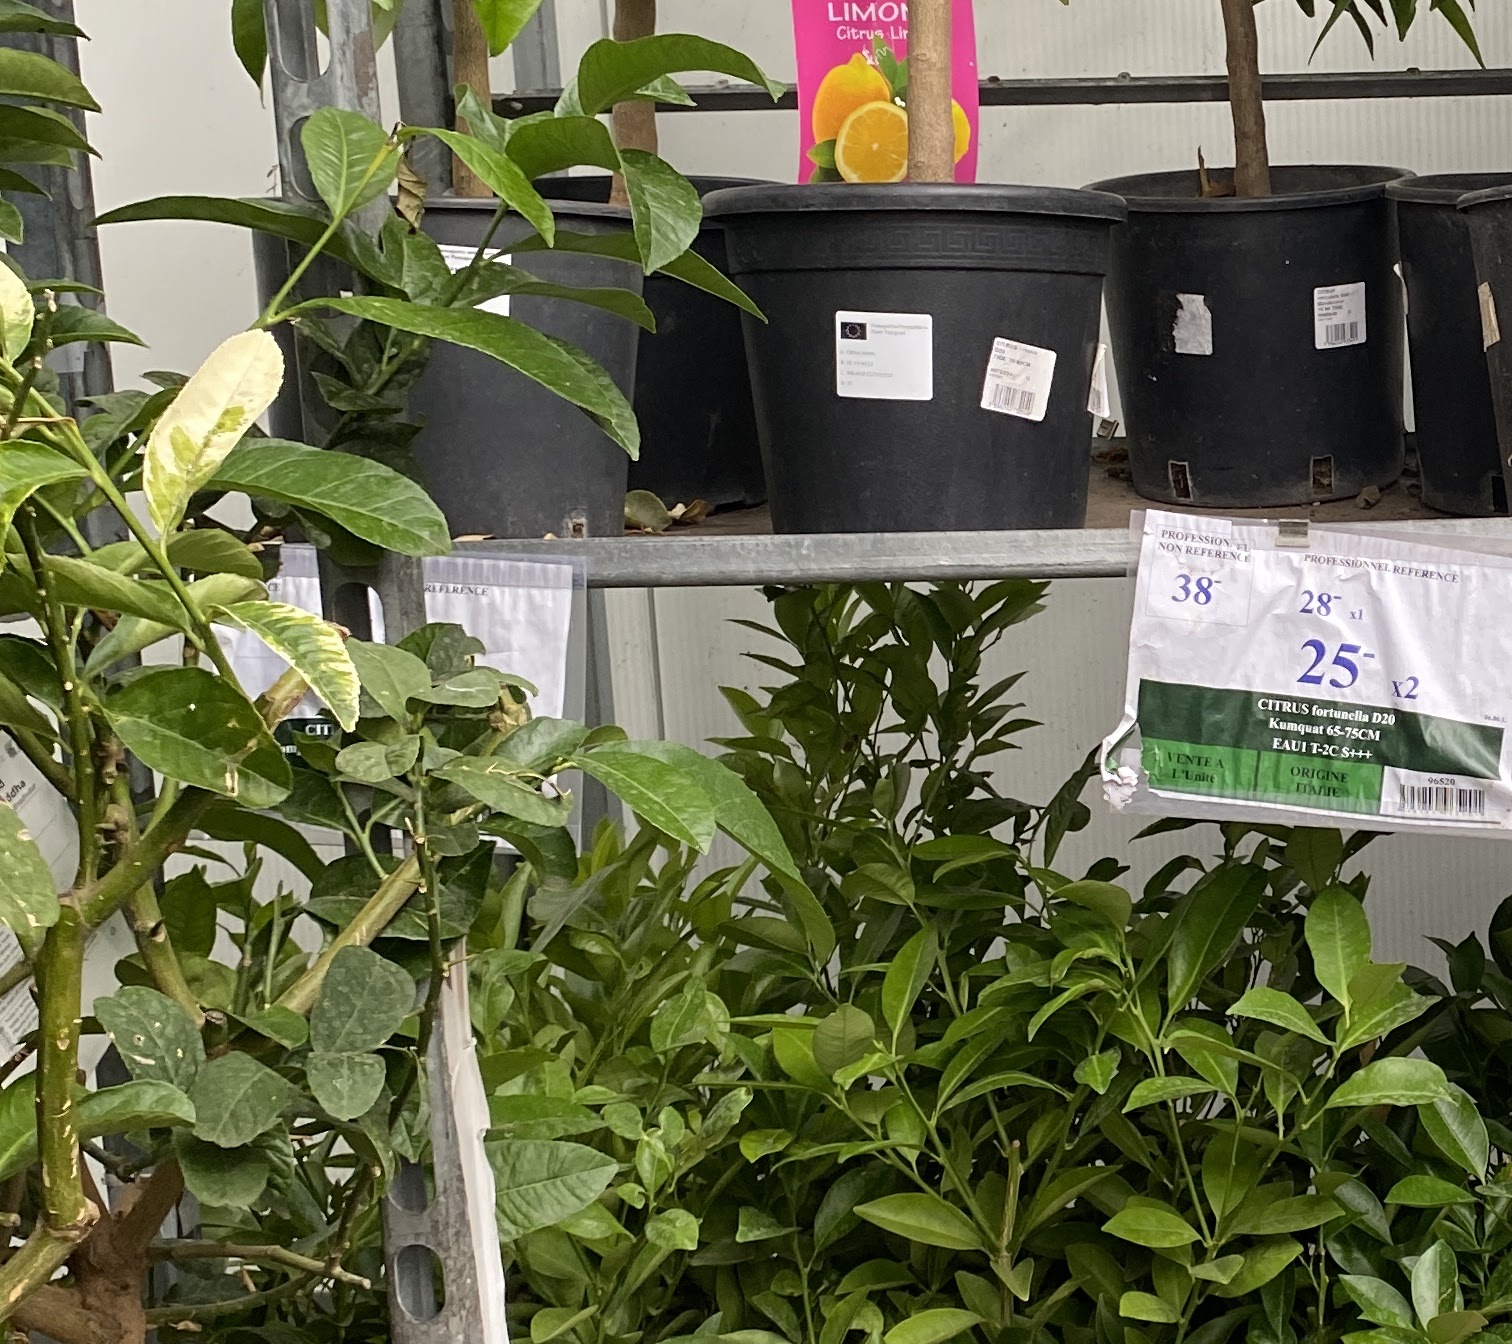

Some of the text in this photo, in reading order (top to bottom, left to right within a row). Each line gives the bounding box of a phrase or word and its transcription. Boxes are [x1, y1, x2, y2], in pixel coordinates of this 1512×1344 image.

[836, 25, 885, 40] Citrus
[1158, 541, 1251, 563] NON REFERENCE
[1303, 554, 1459, 584] PROFESSIONNEL REFERENCE
[424, 583, 489, 597] REFERENCE
[1349, 609, 1363, 620] x1
[1392, 675, 1420, 700] x2
[1257, 698, 1396, 726] CITRUS fortunella D20
[1268, 717, 1381, 742] Kumquat 65-75CM
[1167, 751, 1213, 768] VENTE
[1309, 742, 1340, 757] T-2C
[1340, 747, 1374, 760] S+++
[1290, 766, 1349, 783] ORIGINE
